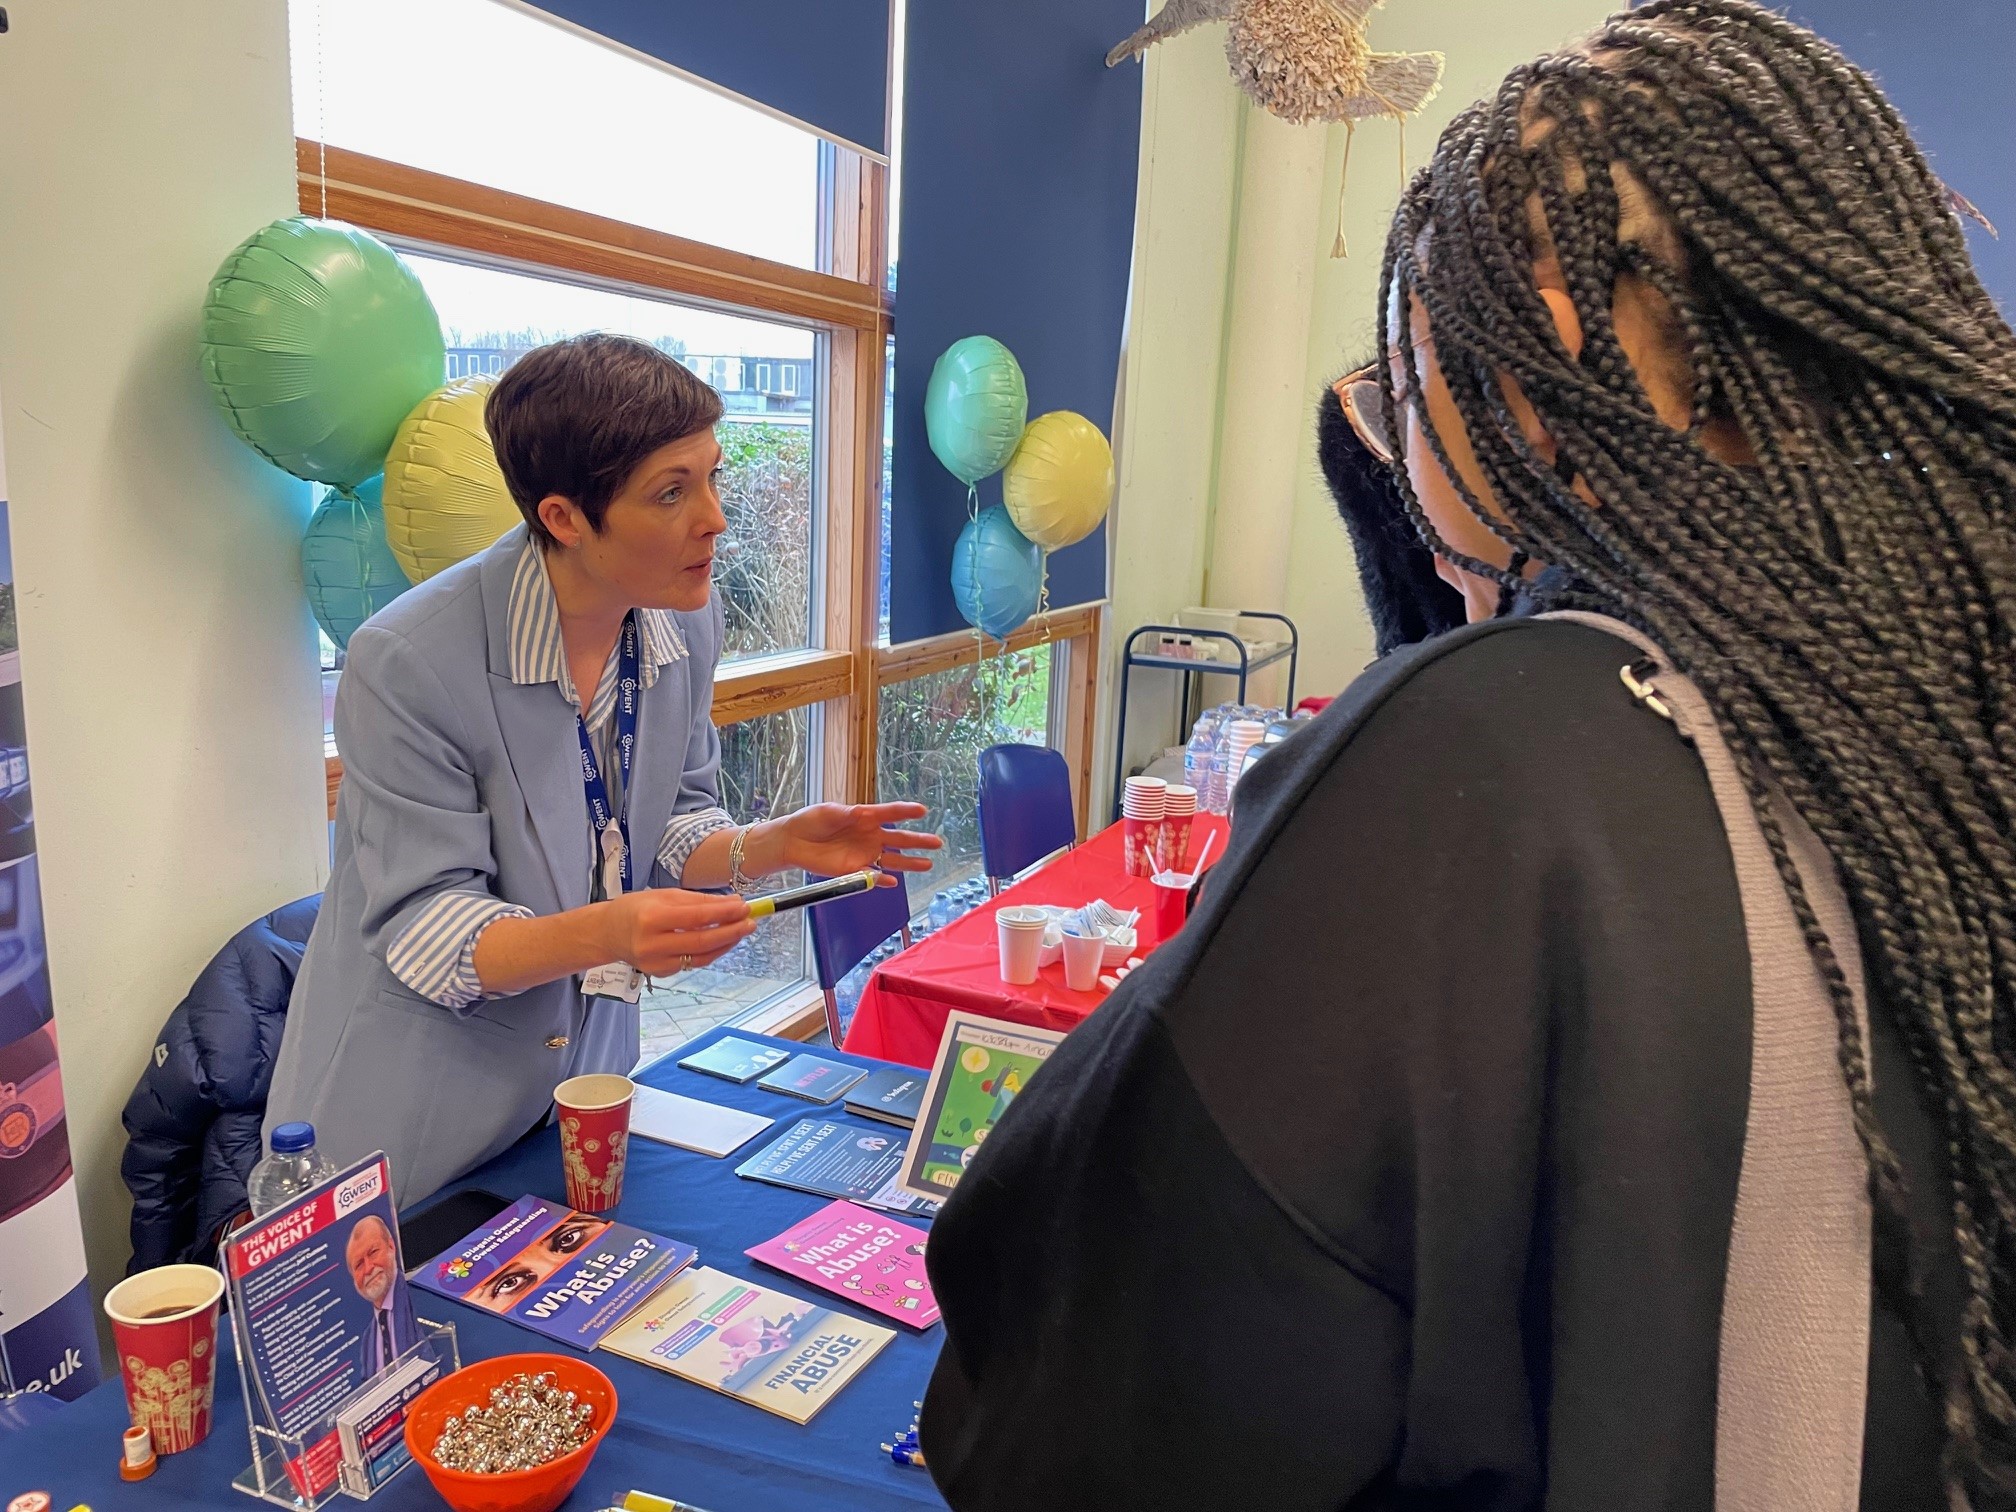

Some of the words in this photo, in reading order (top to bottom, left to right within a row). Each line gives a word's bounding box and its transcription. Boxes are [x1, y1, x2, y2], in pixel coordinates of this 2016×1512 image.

[626, 623, 634, 659] GWENT
[623, 680, 632, 715] GWENT
[581, 749, 594, 779] GWENT
[624, 737, 632, 769] GWENT
[593, 799, 608, 828] GWENT
[797, 1138, 818, 1152] SENT
[816, 1124, 836, 1137] SEXT
[343, 1176, 378, 1202] GWENT
[242, 1232, 266, 1253] THE
[267, 1211, 300, 1237] VOICE
[303, 1201, 318, 1217] OF
[248, 1217, 314, 1267] GWENT
[472, 1242, 500, 1261] Gwent
[497, 1207, 547, 1243] Safeguarding
[493, 1217, 520, 1236] Gwent
[792, 1231, 857, 1266] What
[846, 1221, 874, 1236] is
[576, 1237, 656, 1305] Abuse?
[816, 1226, 902, 1280] Abuse?
[525, 1267, 597, 1319] What
[585, 1252, 615, 1270] is
[577, 1299, 615, 1334] Safeguarding
[765, 1335, 834, 1390] FINANCIAL
[790, 1334, 861, 1394] ABUSE
